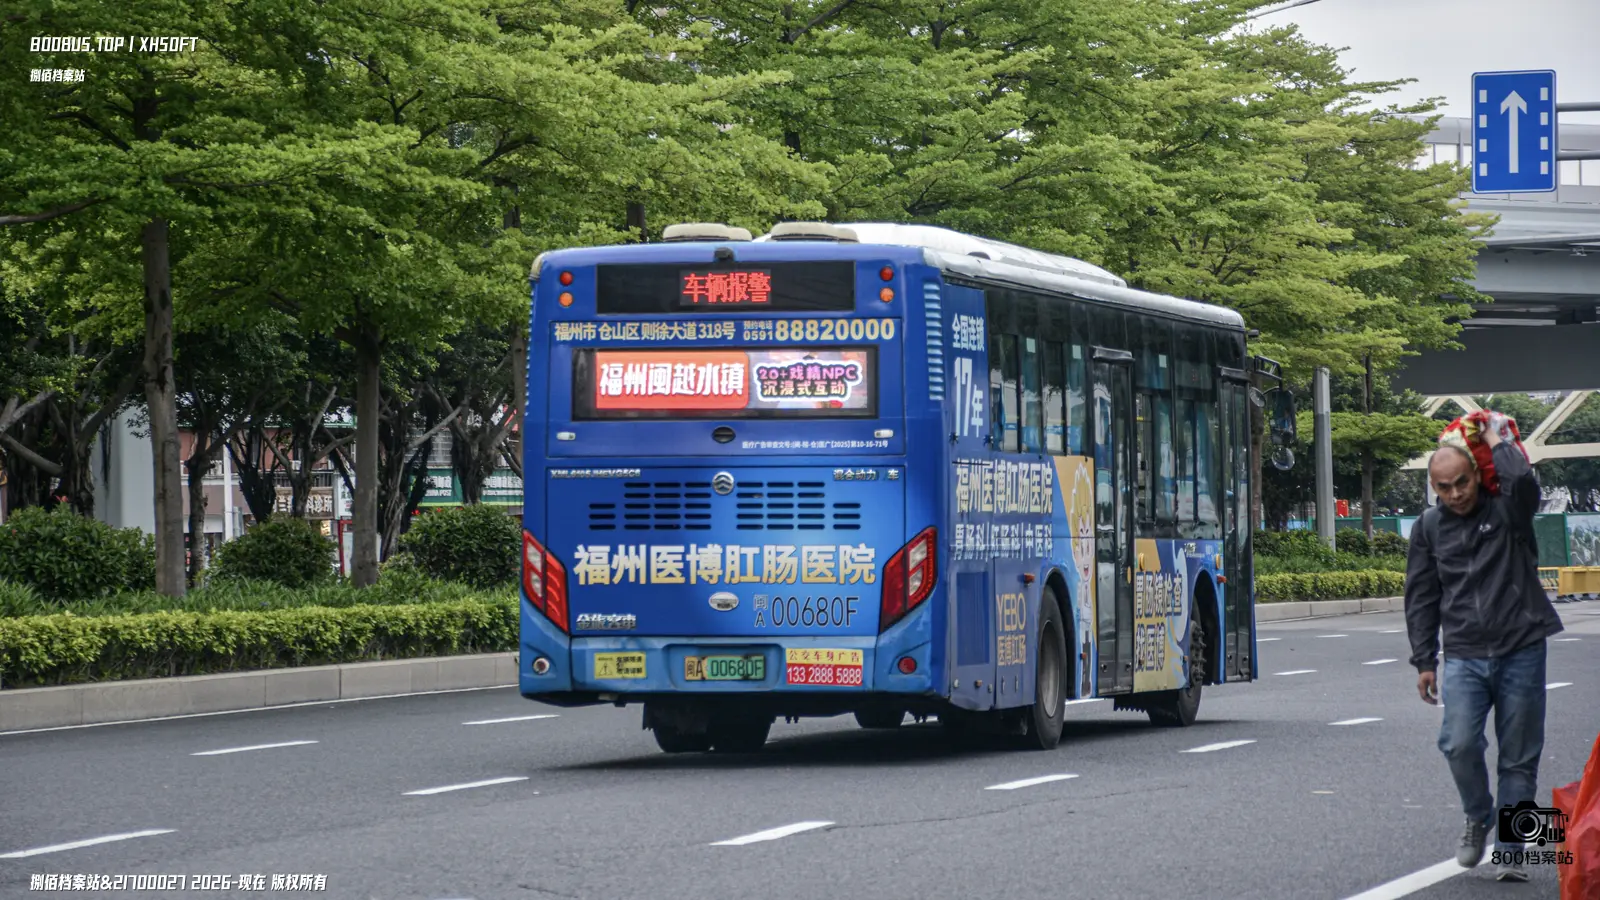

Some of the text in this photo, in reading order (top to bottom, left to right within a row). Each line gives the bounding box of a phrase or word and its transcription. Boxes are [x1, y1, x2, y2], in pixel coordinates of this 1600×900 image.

[682, 273, 772, 302] 车辆报警
[743, 320, 773, 330] 预约电话
[743, 330, 773, 341] 0591
[775, 318, 895, 341] 88820000
[952, 313, 985, 352] 全国连锁
[599, 362, 745, 396] 福州闽越水镇
[759, 366, 857, 380] 20+戏精NPC
[763, 381, 846, 396] 沉浸式互动
[833, 469, 899, 481] 混合动力 车
[956, 458, 1053, 514] 福州医博肛肠医院
[573, 543, 876, 585] 福州医博肛肠医院
[1135, 568, 1183, 618] 胃肠镜检查
[754, 611, 766, 628] A
[771, 595, 859, 628] 00680F
[996, 592, 1027, 632] YEBO
[788, 649, 860, 663] 公交车身广告
[997, 634, 1026, 666] 医博肛肠
[710, 658, 764, 678] 00680F
[787, 666, 862, 685] 133 2888 5888
